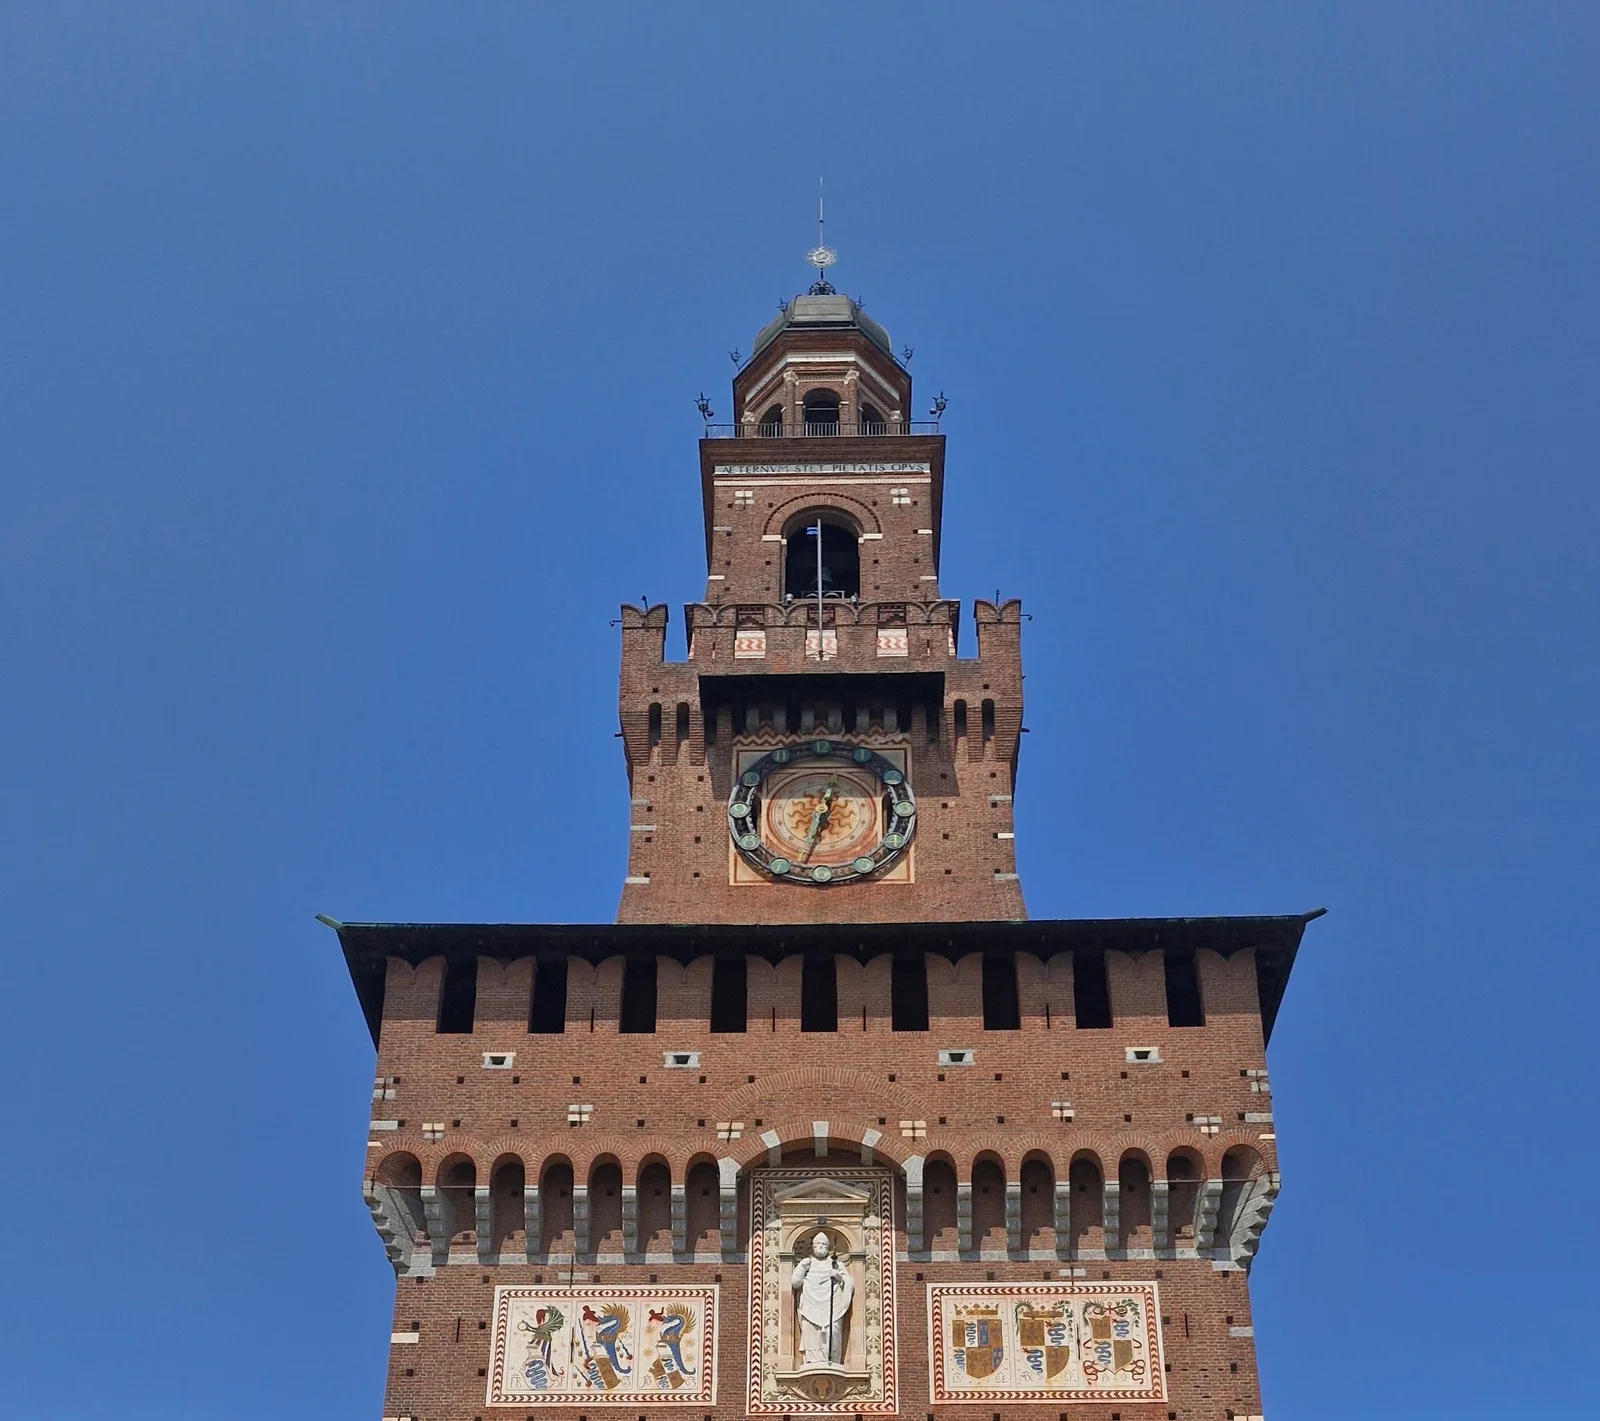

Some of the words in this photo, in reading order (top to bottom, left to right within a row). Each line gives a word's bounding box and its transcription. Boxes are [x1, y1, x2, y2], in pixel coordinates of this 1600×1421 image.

[722, 465, 788, 473] AETERNVM
[795, 464, 825, 472] STET
[832, 463, 886, 471] PIETATIS
[891, 463, 924, 471] OPVS
[816, 741, 829, 753] 12
[776, 749, 786, 761] 11
[744, 836, 754, 847] 8
[886, 834, 900, 847] 4
[775, 860, 783, 872] 7
